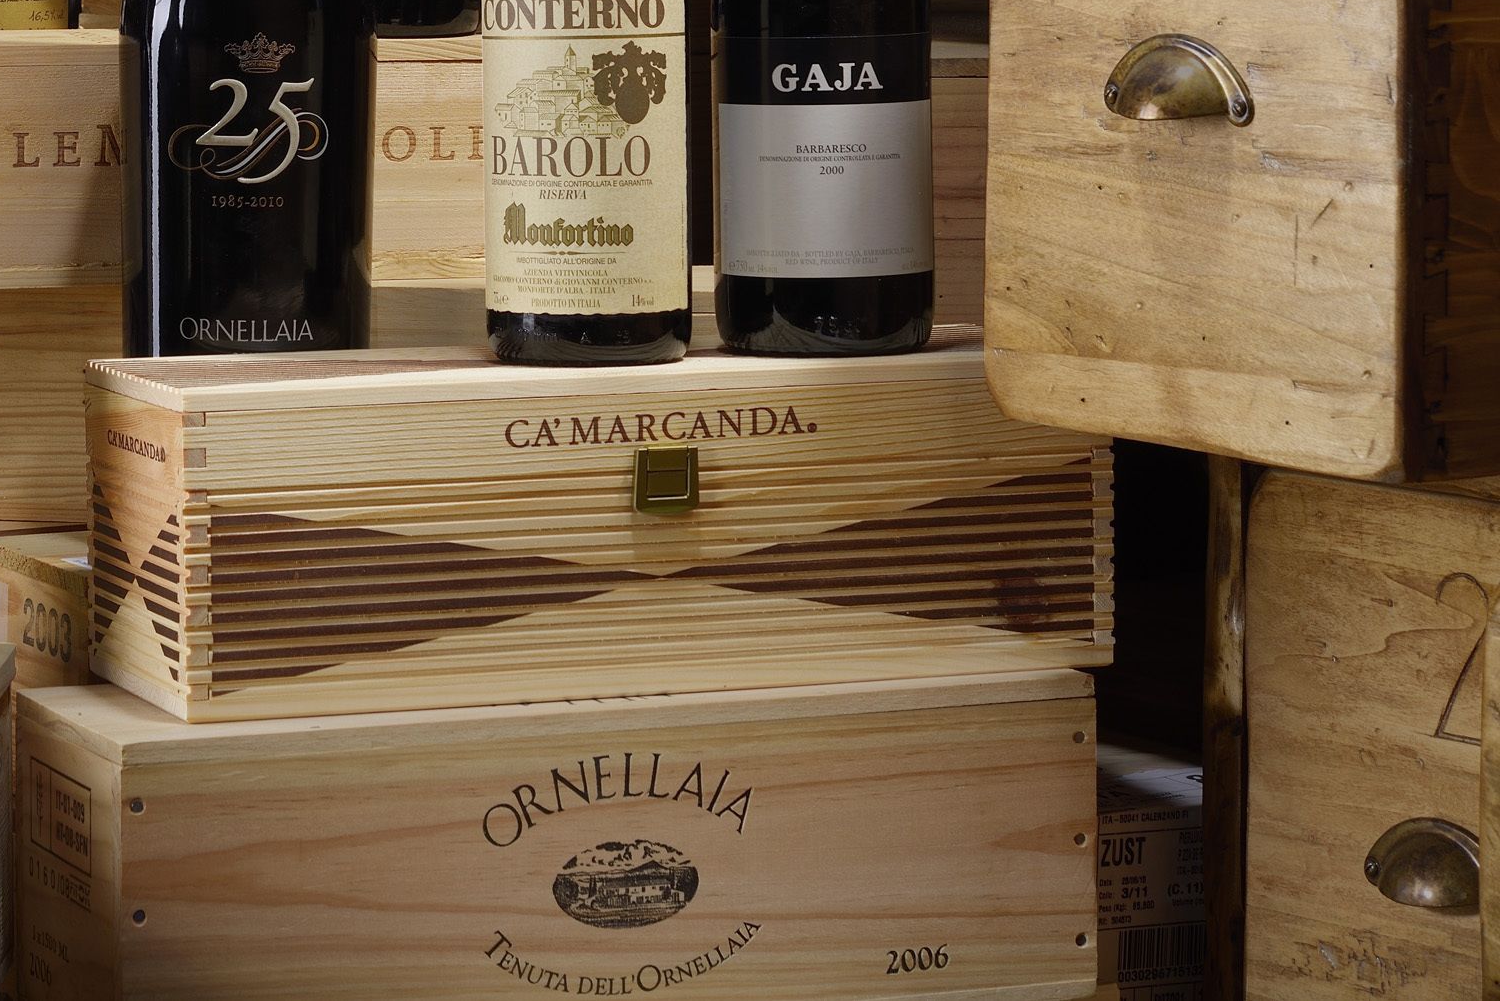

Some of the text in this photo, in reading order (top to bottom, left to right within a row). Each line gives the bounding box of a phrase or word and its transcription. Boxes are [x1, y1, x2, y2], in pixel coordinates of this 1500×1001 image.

[771, 61, 884, 93] GAJA
[195, 77, 315, 185] 25
[491, 134, 652, 178] BAROLO
[796, 143, 867, 154] BARBARESCO
[819, 165, 845, 175] 2000
[536, 179, 563, 188] ORIGINE
[563, 180, 612, 188] CONTROLLATA
[618, 178, 653, 187] GARANTITA
[211, 194, 284, 209] 1985-2010
[538, 189, 588, 200] RISERVA
[502, 200, 634, 248] Monfortino
[516, 256, 617, 265] IMBOTTIGLIATO ALL'ORIGINE DA
[515, 277, 554, 285] CONTERNO
[561, 277, 600, 286] GIOVANNI
[601, 277, 643, 286] CONTERNO
[522, 269, 609, 277] AZIENDA VITIVINICOLA
[556, 286, 584, 294] D'ALBA
[577, 298, 601, 307] ITALIA
[179, 316, 314, 343] ORNELLAIA
[22, 597, 72, 663] 2003
[482, 752, 755, 848] ORNELLAIA
[1100, 836, 1146, 867] ZUST
[482, 919, 763, 996] TENUTA DELL'ORNELLAIA
[886, 943, 951, 975] 2006
